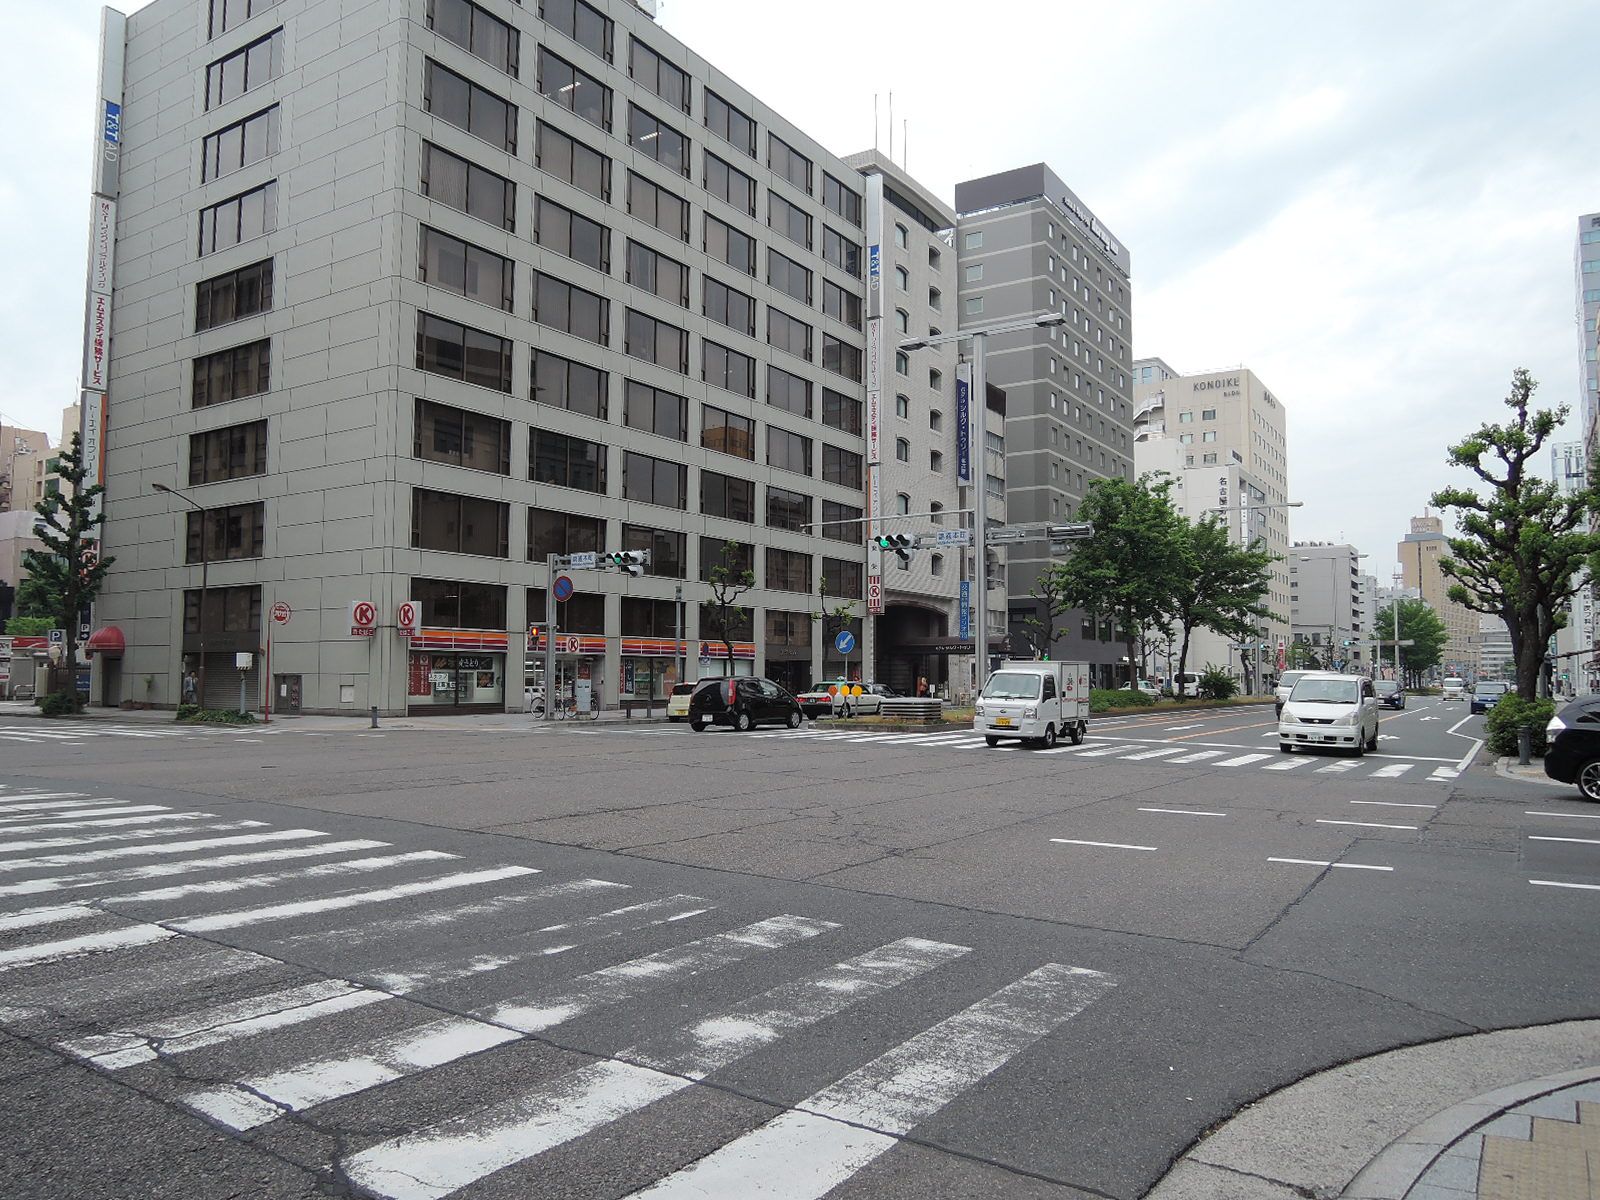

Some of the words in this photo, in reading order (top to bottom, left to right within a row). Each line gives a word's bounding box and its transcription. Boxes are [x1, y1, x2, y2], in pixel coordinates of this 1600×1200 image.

[106, 113, 120, 140] T&T
[1193, 377, 1240, 391] KONOIKE
[51, 631, 60, 641] P
